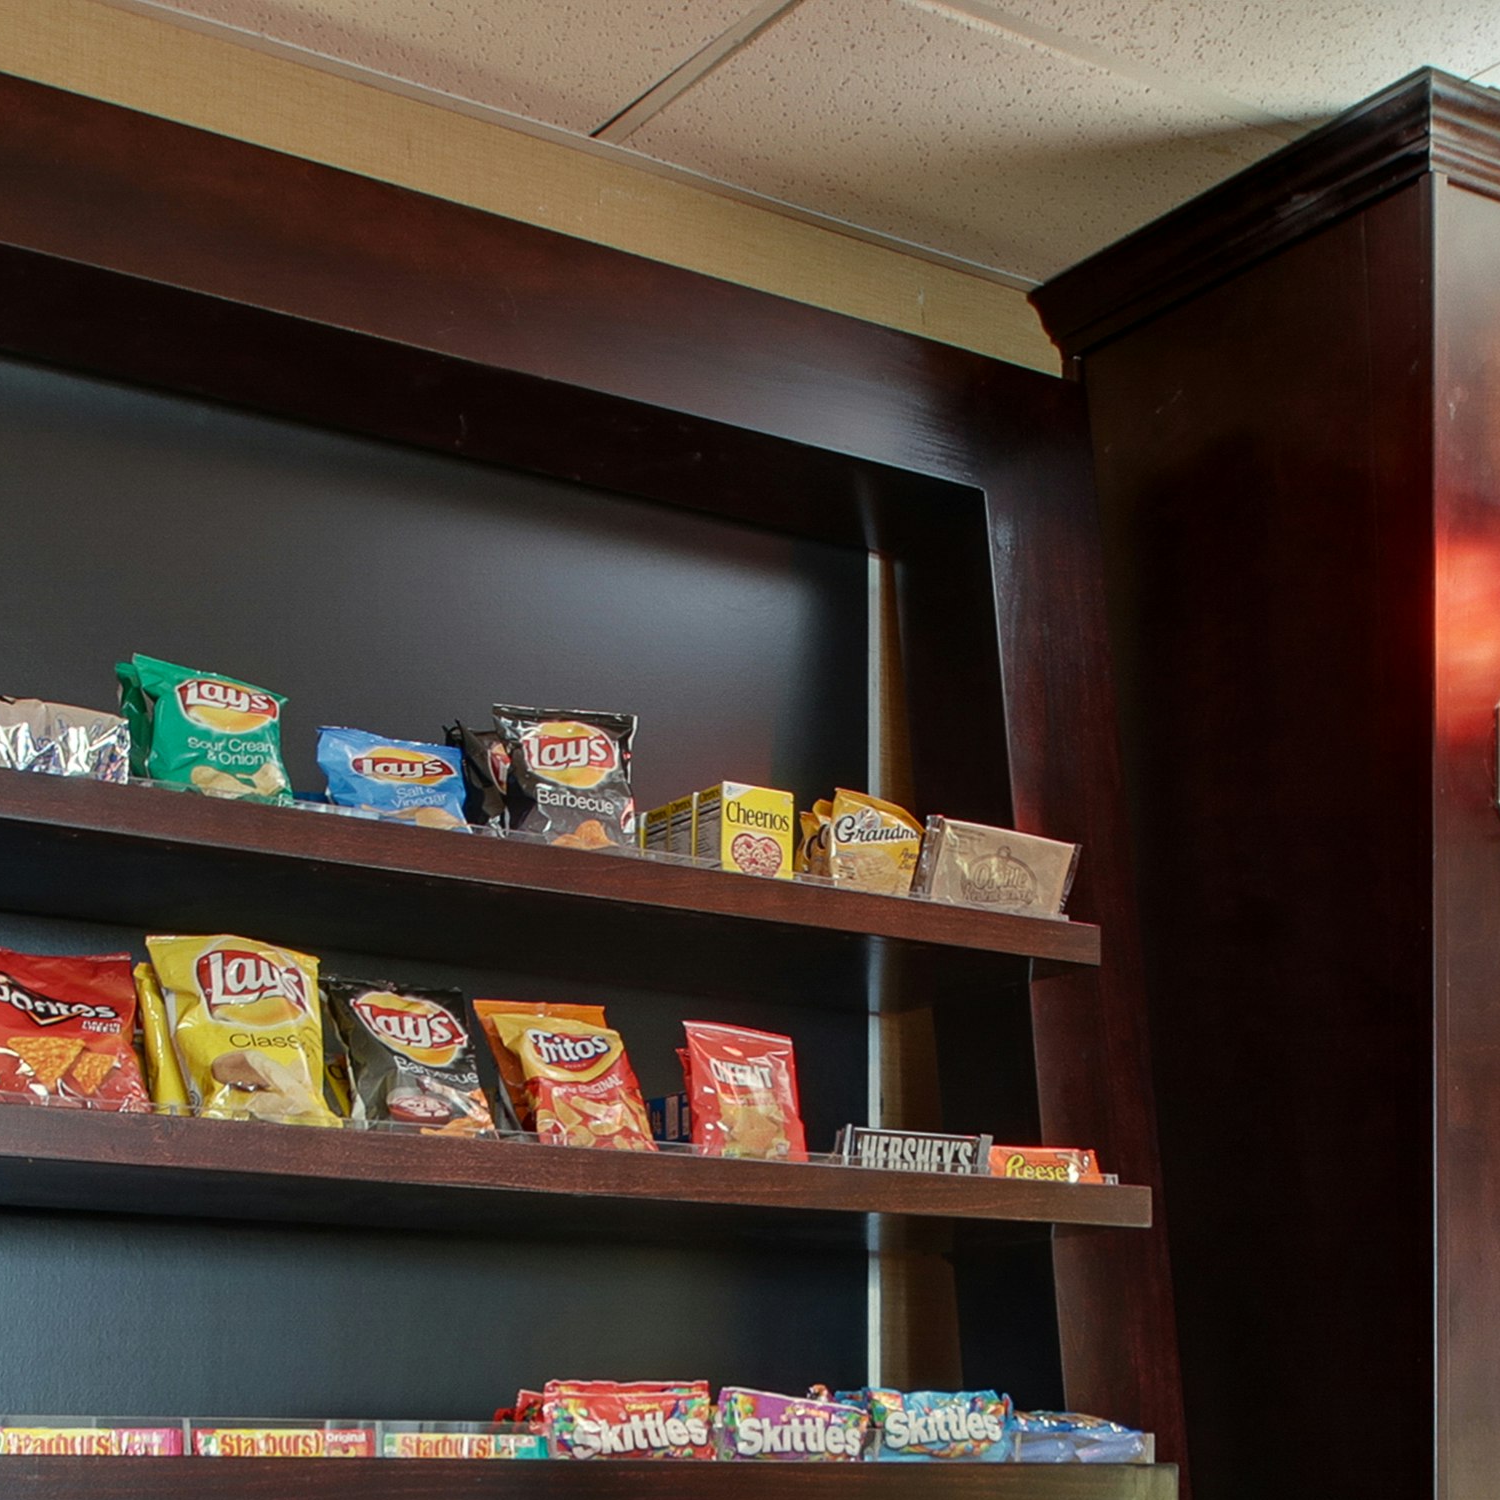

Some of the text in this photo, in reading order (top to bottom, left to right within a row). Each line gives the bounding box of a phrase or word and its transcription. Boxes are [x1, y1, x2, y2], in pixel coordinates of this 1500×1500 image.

[186, 680, 271, 713] Lay's
[188, 736, 226, 752] Sour
[206, 749, 265, 766] & Onion
[528, 736, 609, 770] Lay's
[362, 758, 444, 778] Lay's
[390, 793, 447, 809] Vinegar
[396, 785, 425, 800] Salt
[536, 787, 615, 815] Barbecue
[726, 800, 790, 832] Cheerios
[974, 863, 1029, 891] Orille
[208, 951, 300, 1005] Lay's
[229, 1032, 304, 1050] Class
[359, 1005, 453, 1048] Lay's
[525, 1028, 610, 1064] Fritos
[860, 1134, 974, 1175] HERSHEY'S
[1005, 1153, 1075, 1181] Reese'
[572, 1410, 708, 1459] Skittles
[737, 1417, 861, 1456] Skittles
[885, 1407, 1002, 1450] Skittles
[220, 1431, 324, 1457] Starburst
